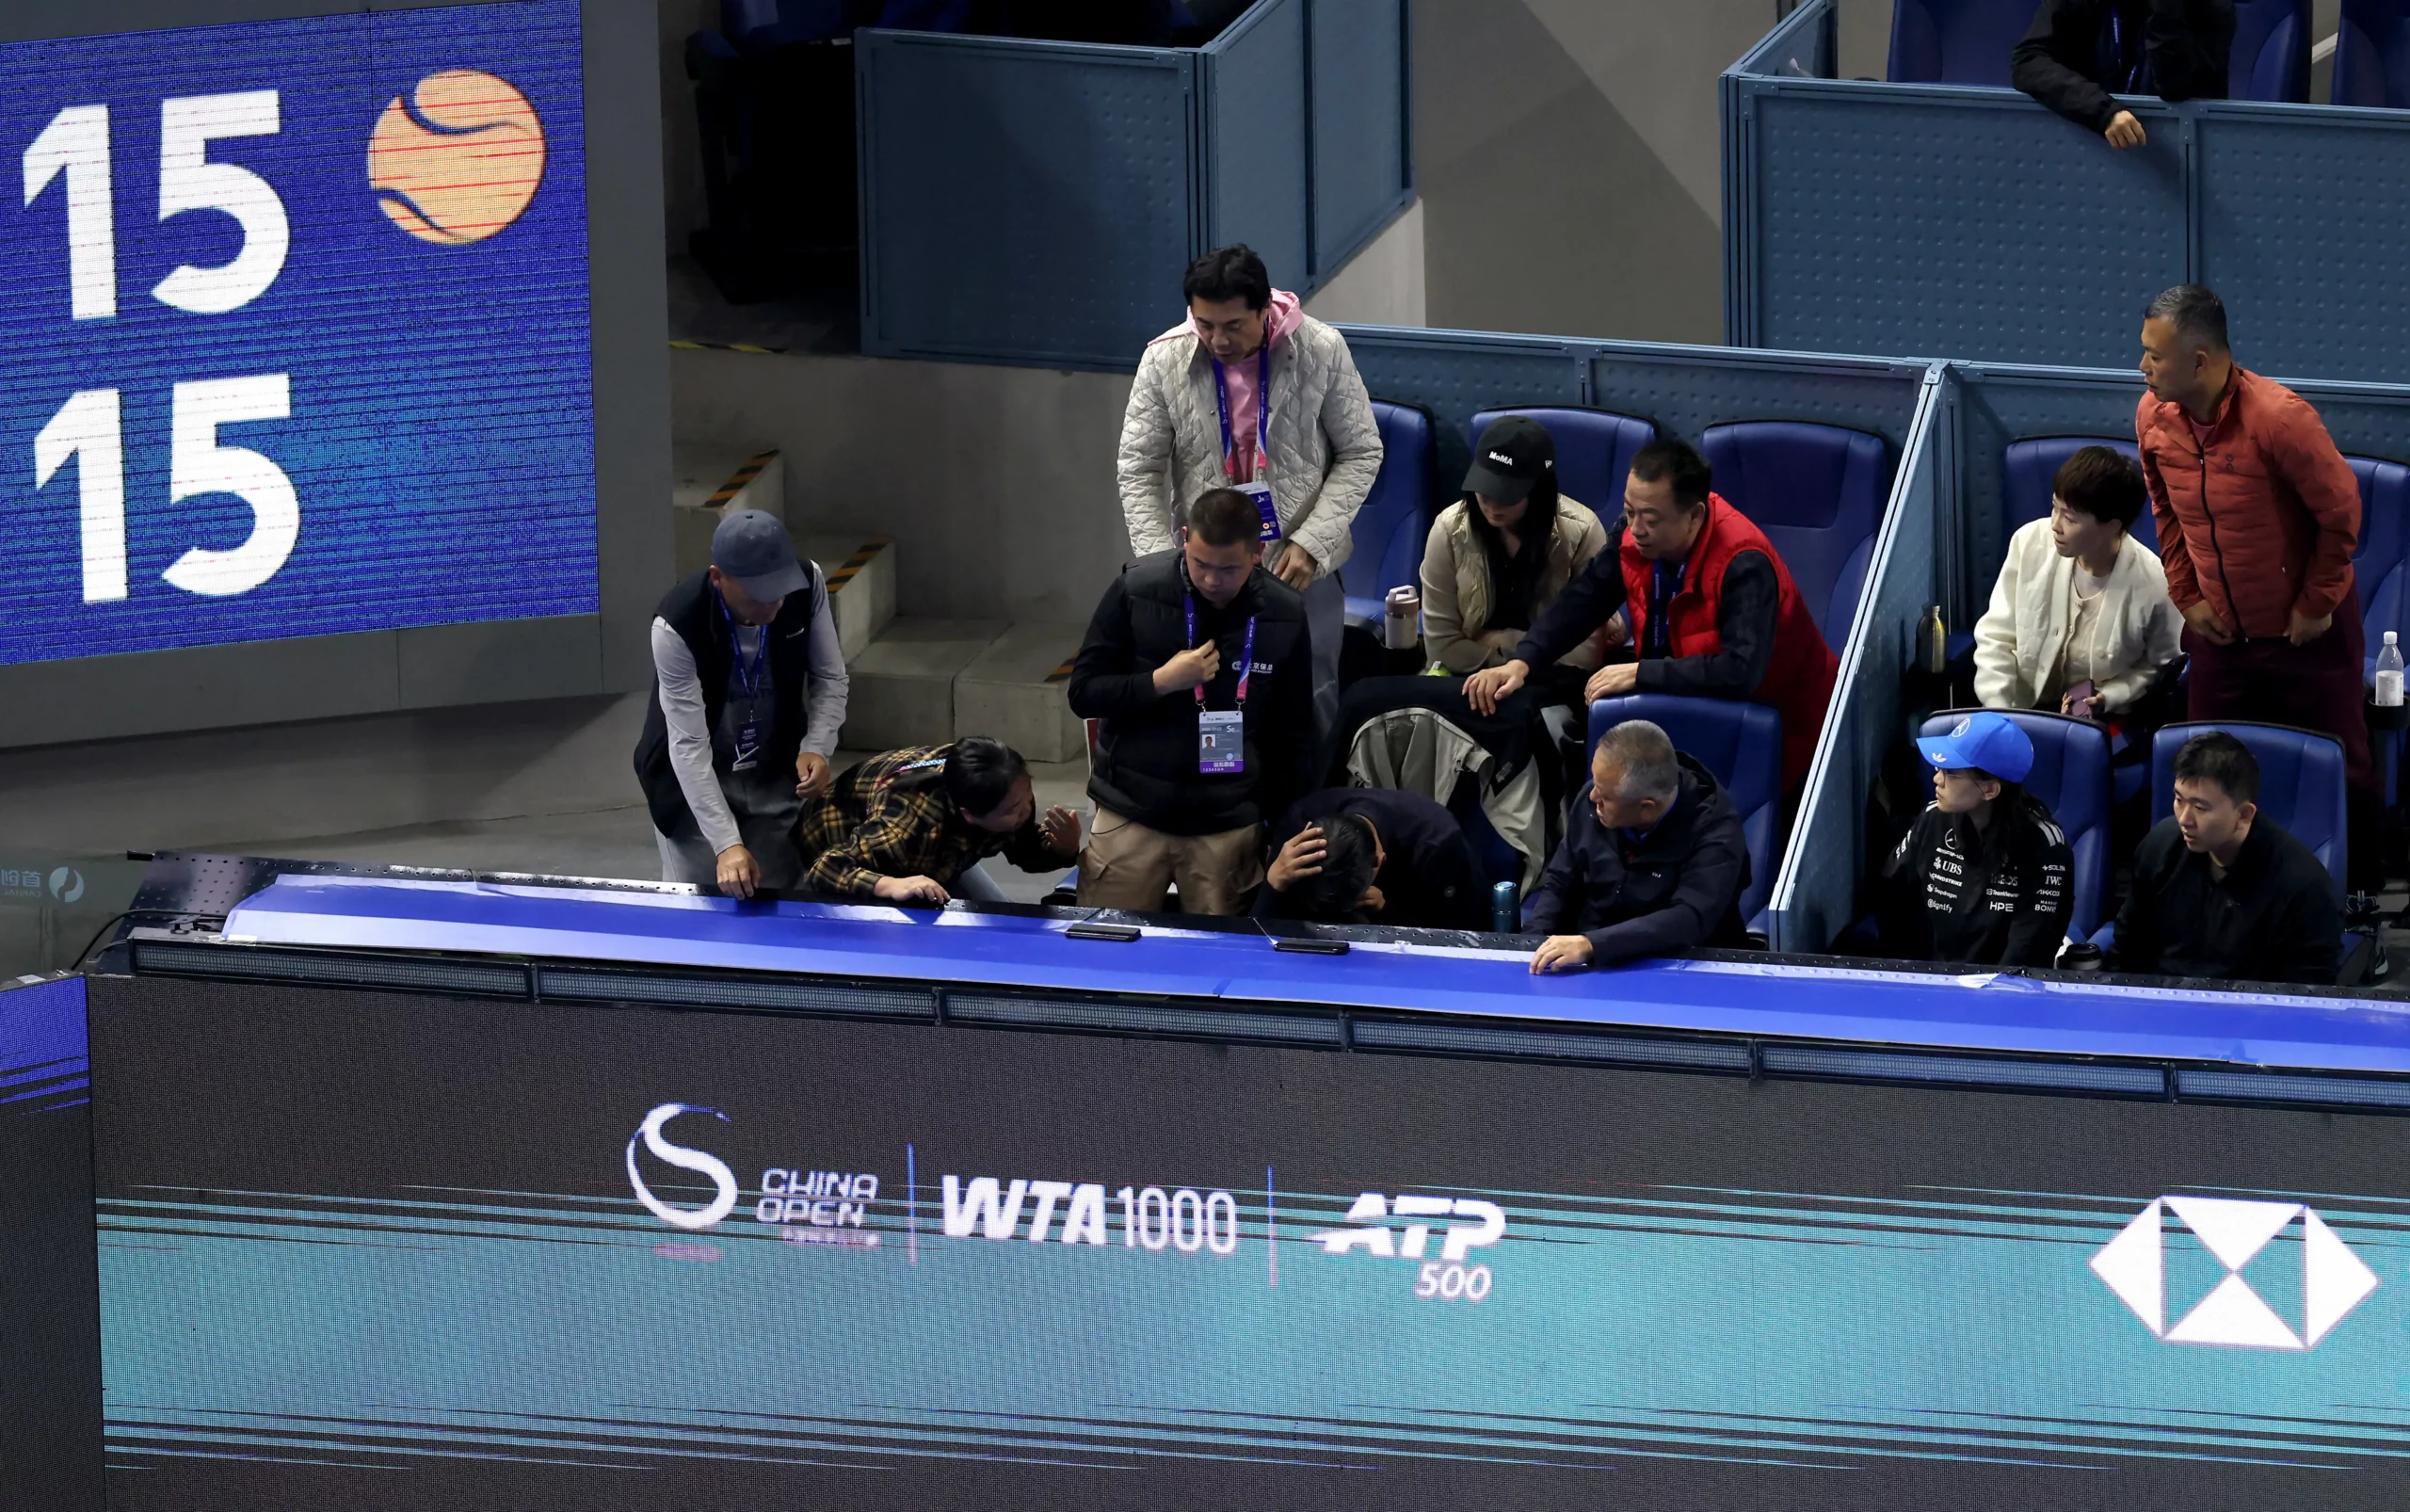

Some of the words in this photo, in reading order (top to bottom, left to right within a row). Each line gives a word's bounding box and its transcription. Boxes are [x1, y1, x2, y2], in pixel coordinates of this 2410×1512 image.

[23, 89, 290, 320] 15
[1488, 451, 1513, 466] MoMA
[34, 373, 300, 604] 15
[1942, 861, 1963, 875] UBS
[2045, 875, 2063, 885] IWC
[1989, 901, 2014, 912] HPE
[763, 1167, 878, 1201] CHINA
[756, 1196, 865, 1228] OPEN
[941, 1174, 1105, 1246] WTA
[1117, 1185, 1236, 1255] 1000
[1305, 1192, 1506, 1262] ATP
[1414, 1259, 1493, 1302] 500
